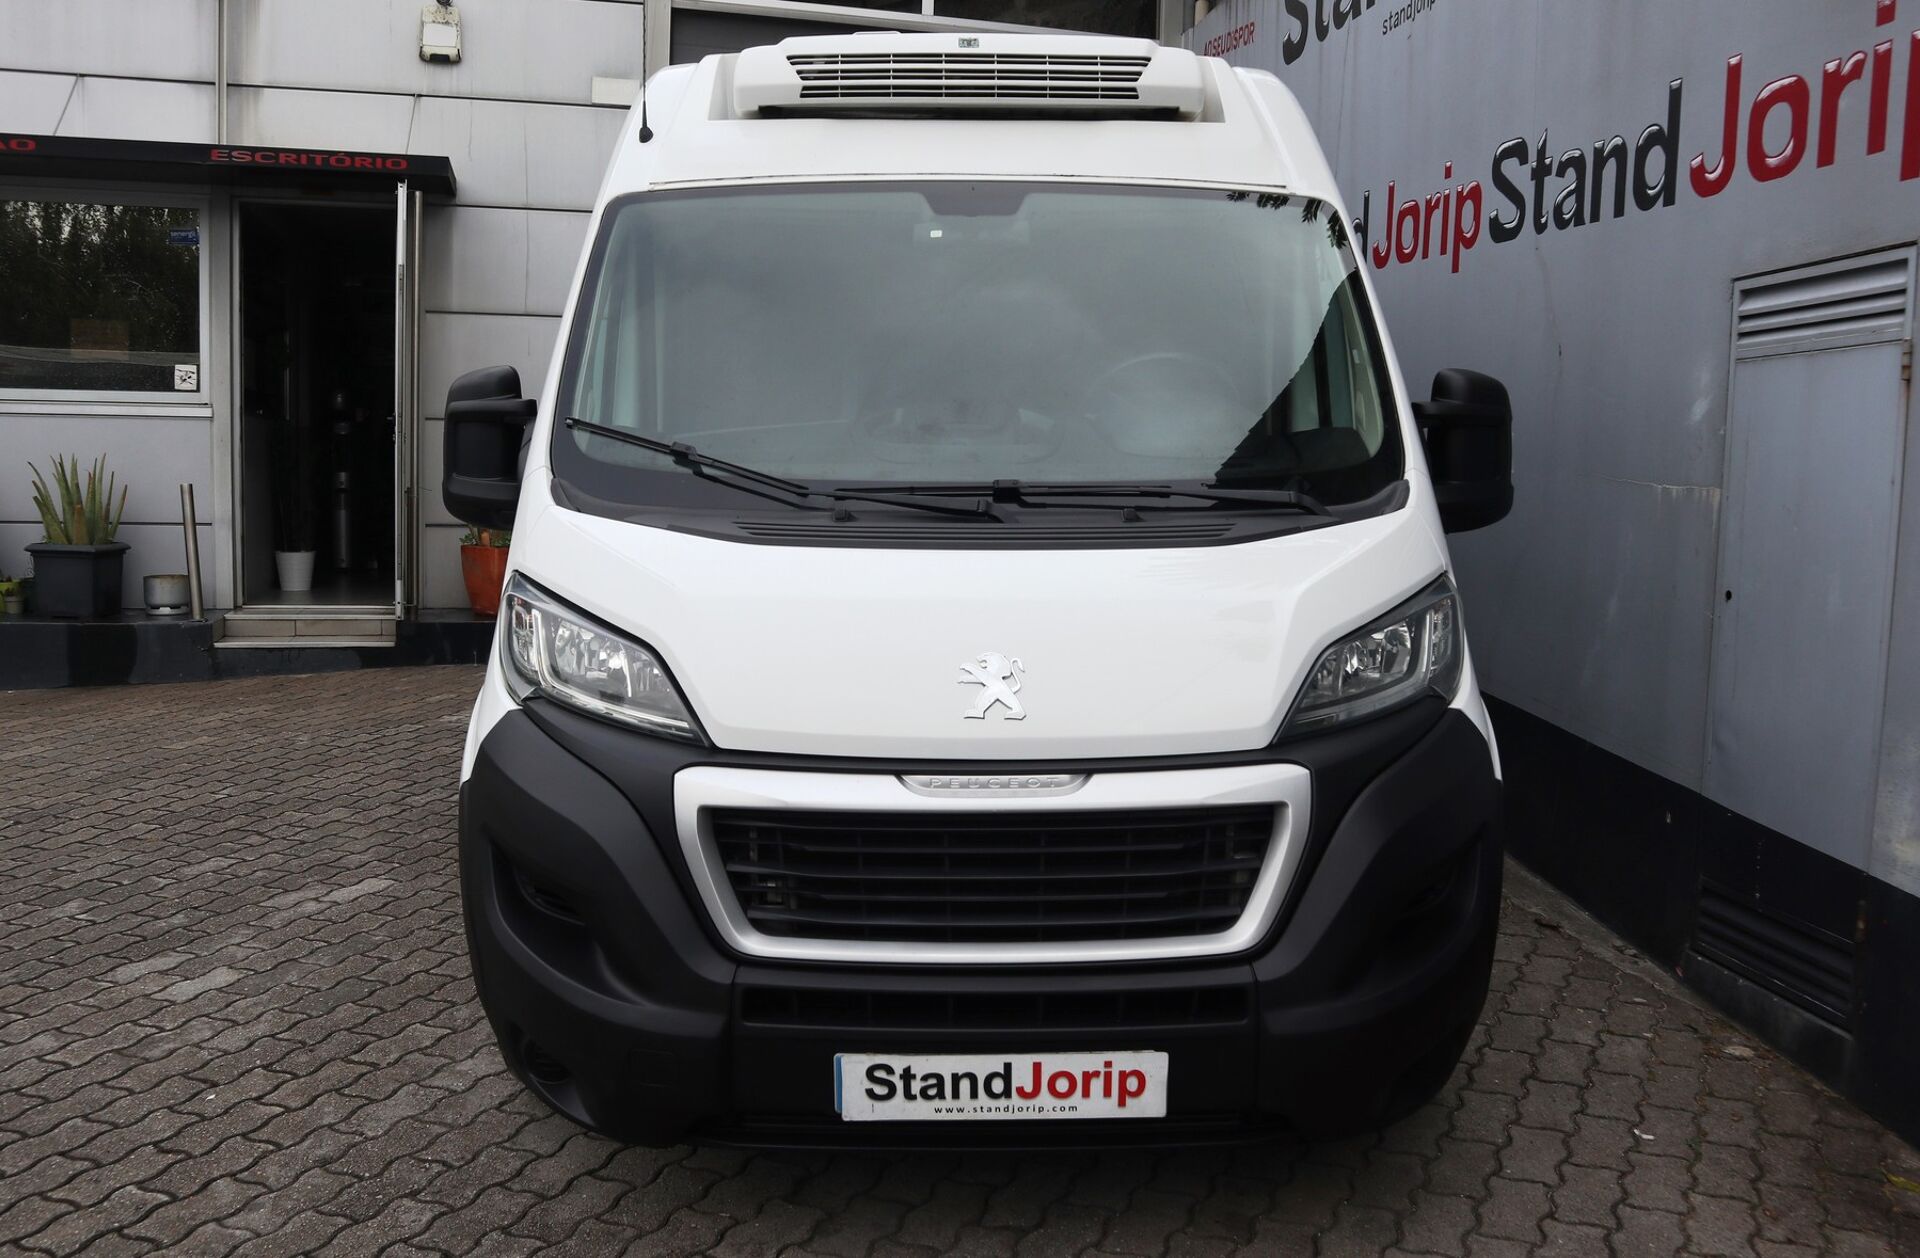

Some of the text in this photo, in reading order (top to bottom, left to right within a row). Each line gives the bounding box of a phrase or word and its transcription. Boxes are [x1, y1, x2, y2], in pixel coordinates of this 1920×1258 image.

[210, 149, 408, 170] ESCRITÓRIO
[929, 777, 1060, 789] PEUGEOT
[934, 1104, 1079, 1114] www.standjorip.com
